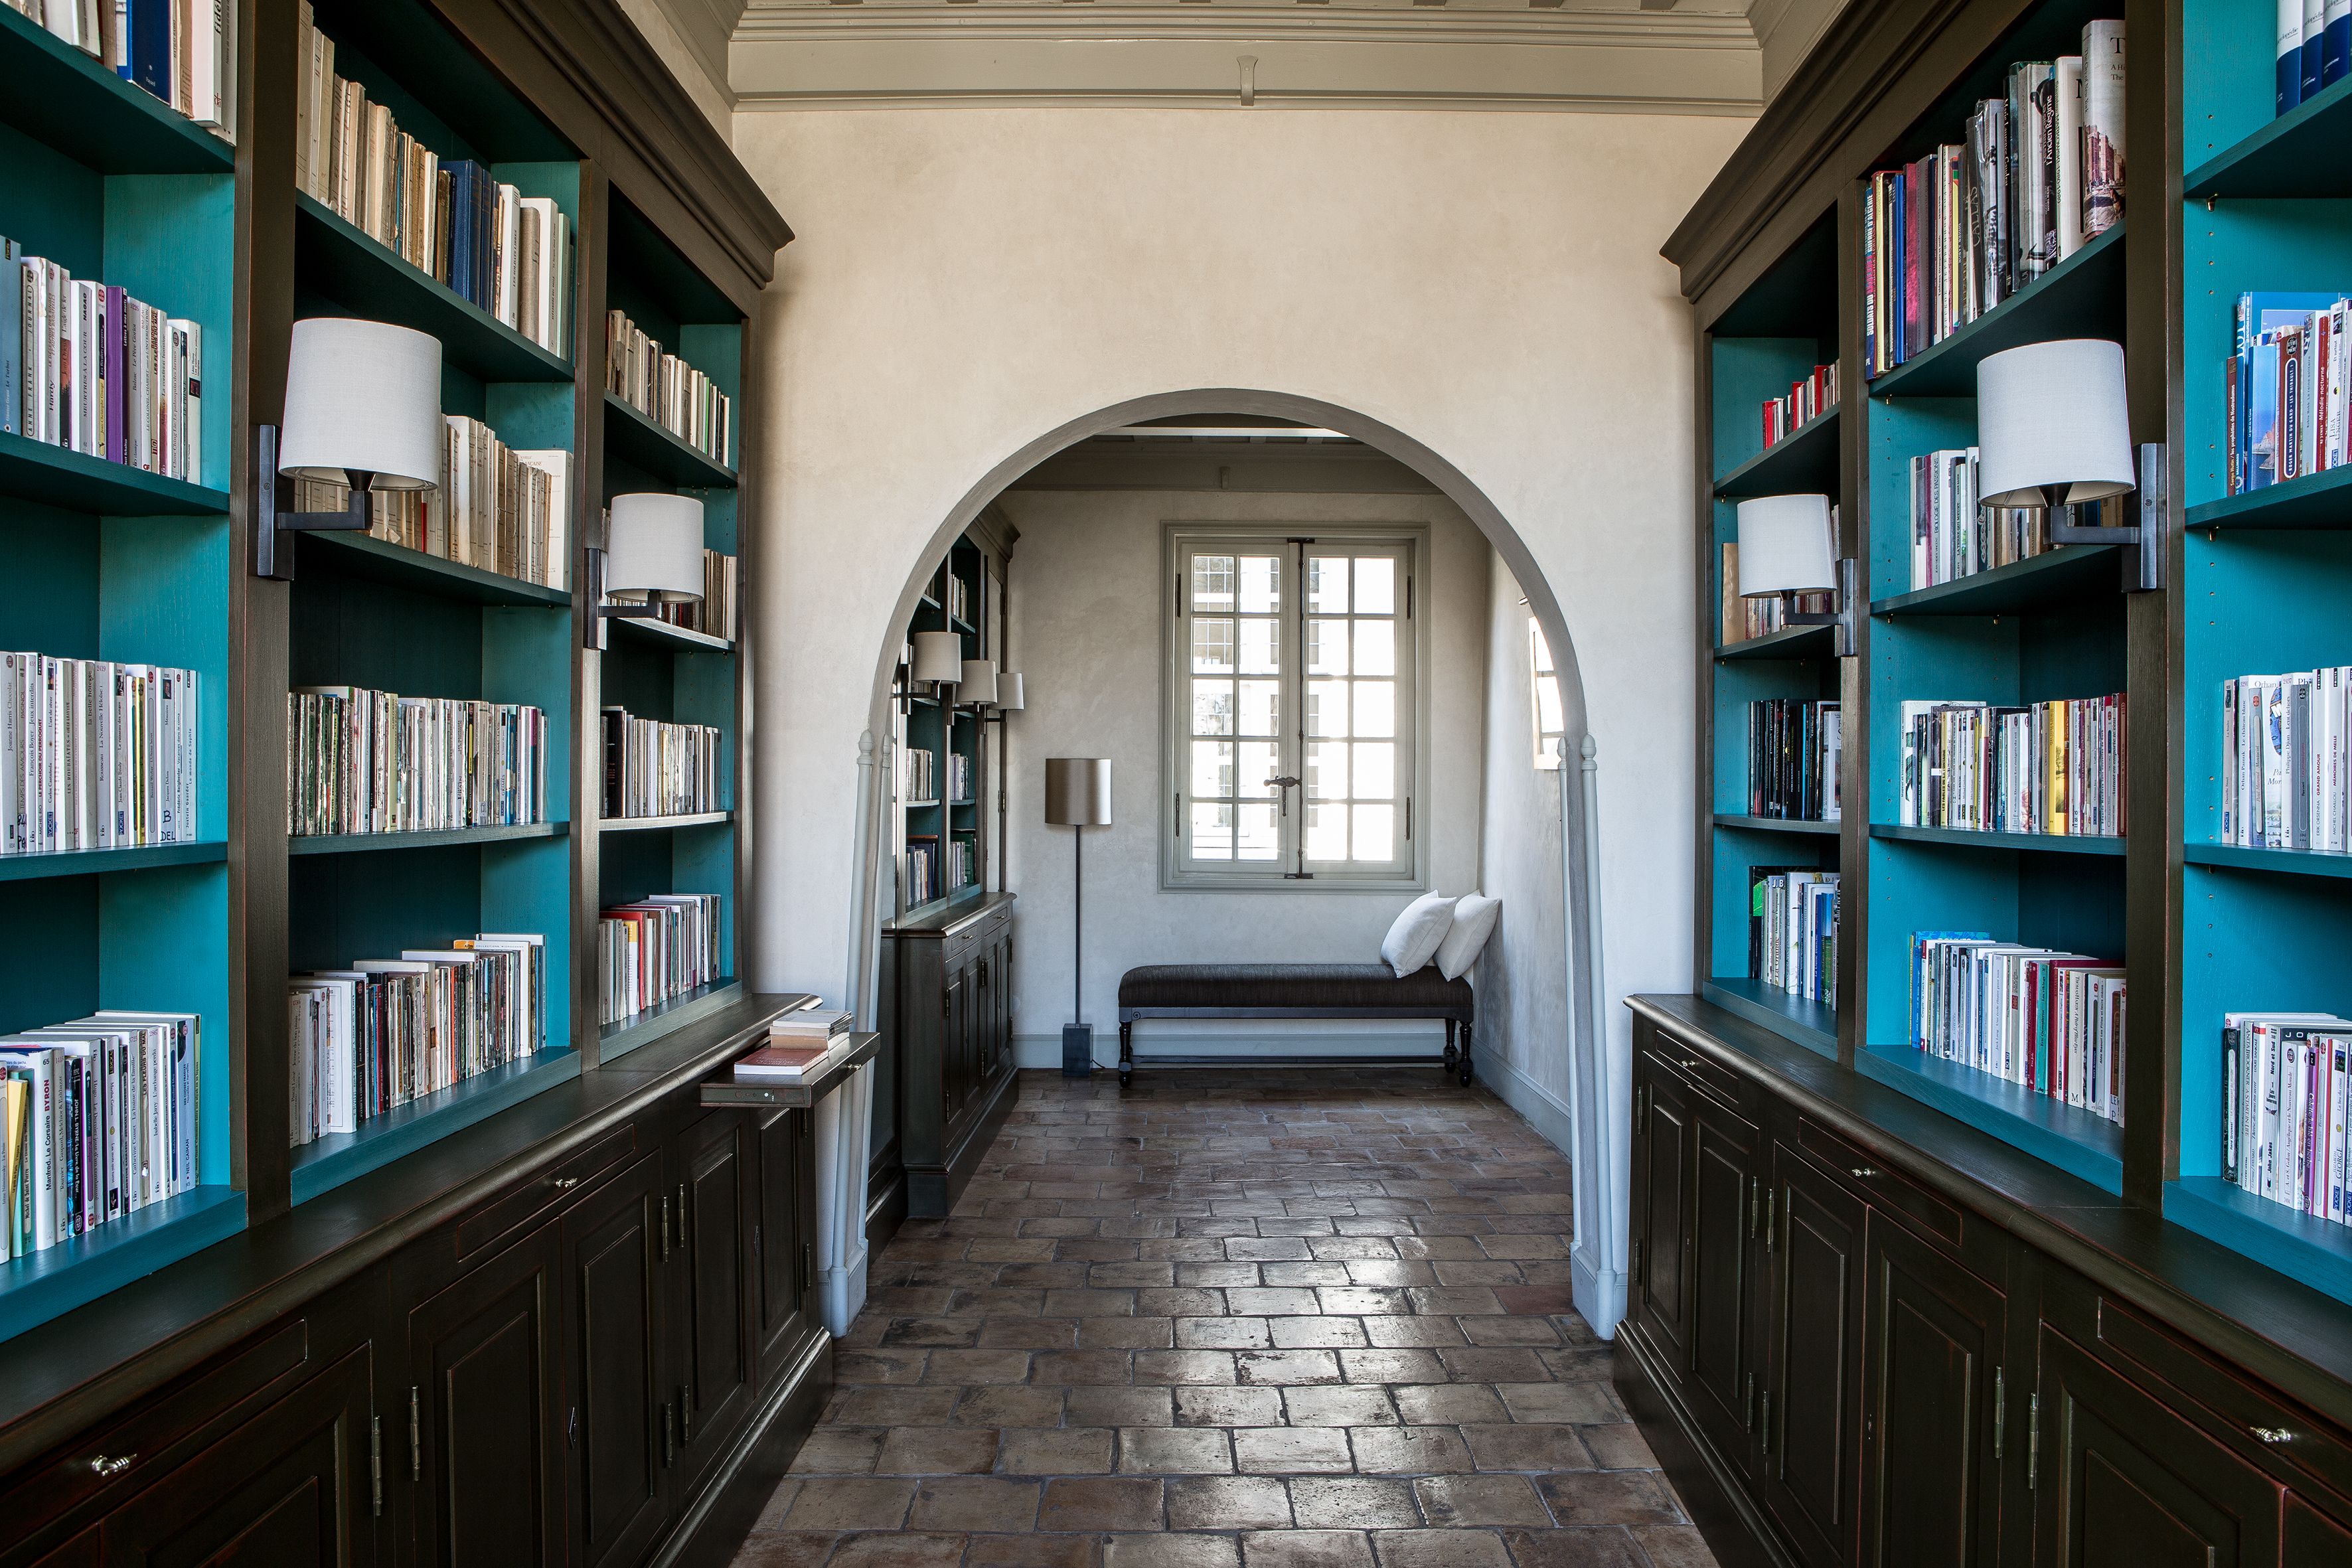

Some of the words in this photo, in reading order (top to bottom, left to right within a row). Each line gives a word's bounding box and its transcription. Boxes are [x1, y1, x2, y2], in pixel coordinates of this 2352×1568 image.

[2045, 95, 2055, 127] Régime
[1969, 186, 1980, 247] CALLAS
[99, 740, 104, 748] La
[163, 810, 171, 824] B
[161, 830, 175, 842] DEL
[1774, 969, 1779, 978] La
[141, 1046, 147, 1056] DU
[2071, 1093, 2078, 1103] M
[2308, 1138, 2312, 1146] en
[45, 1147, 51, 1157] Le
